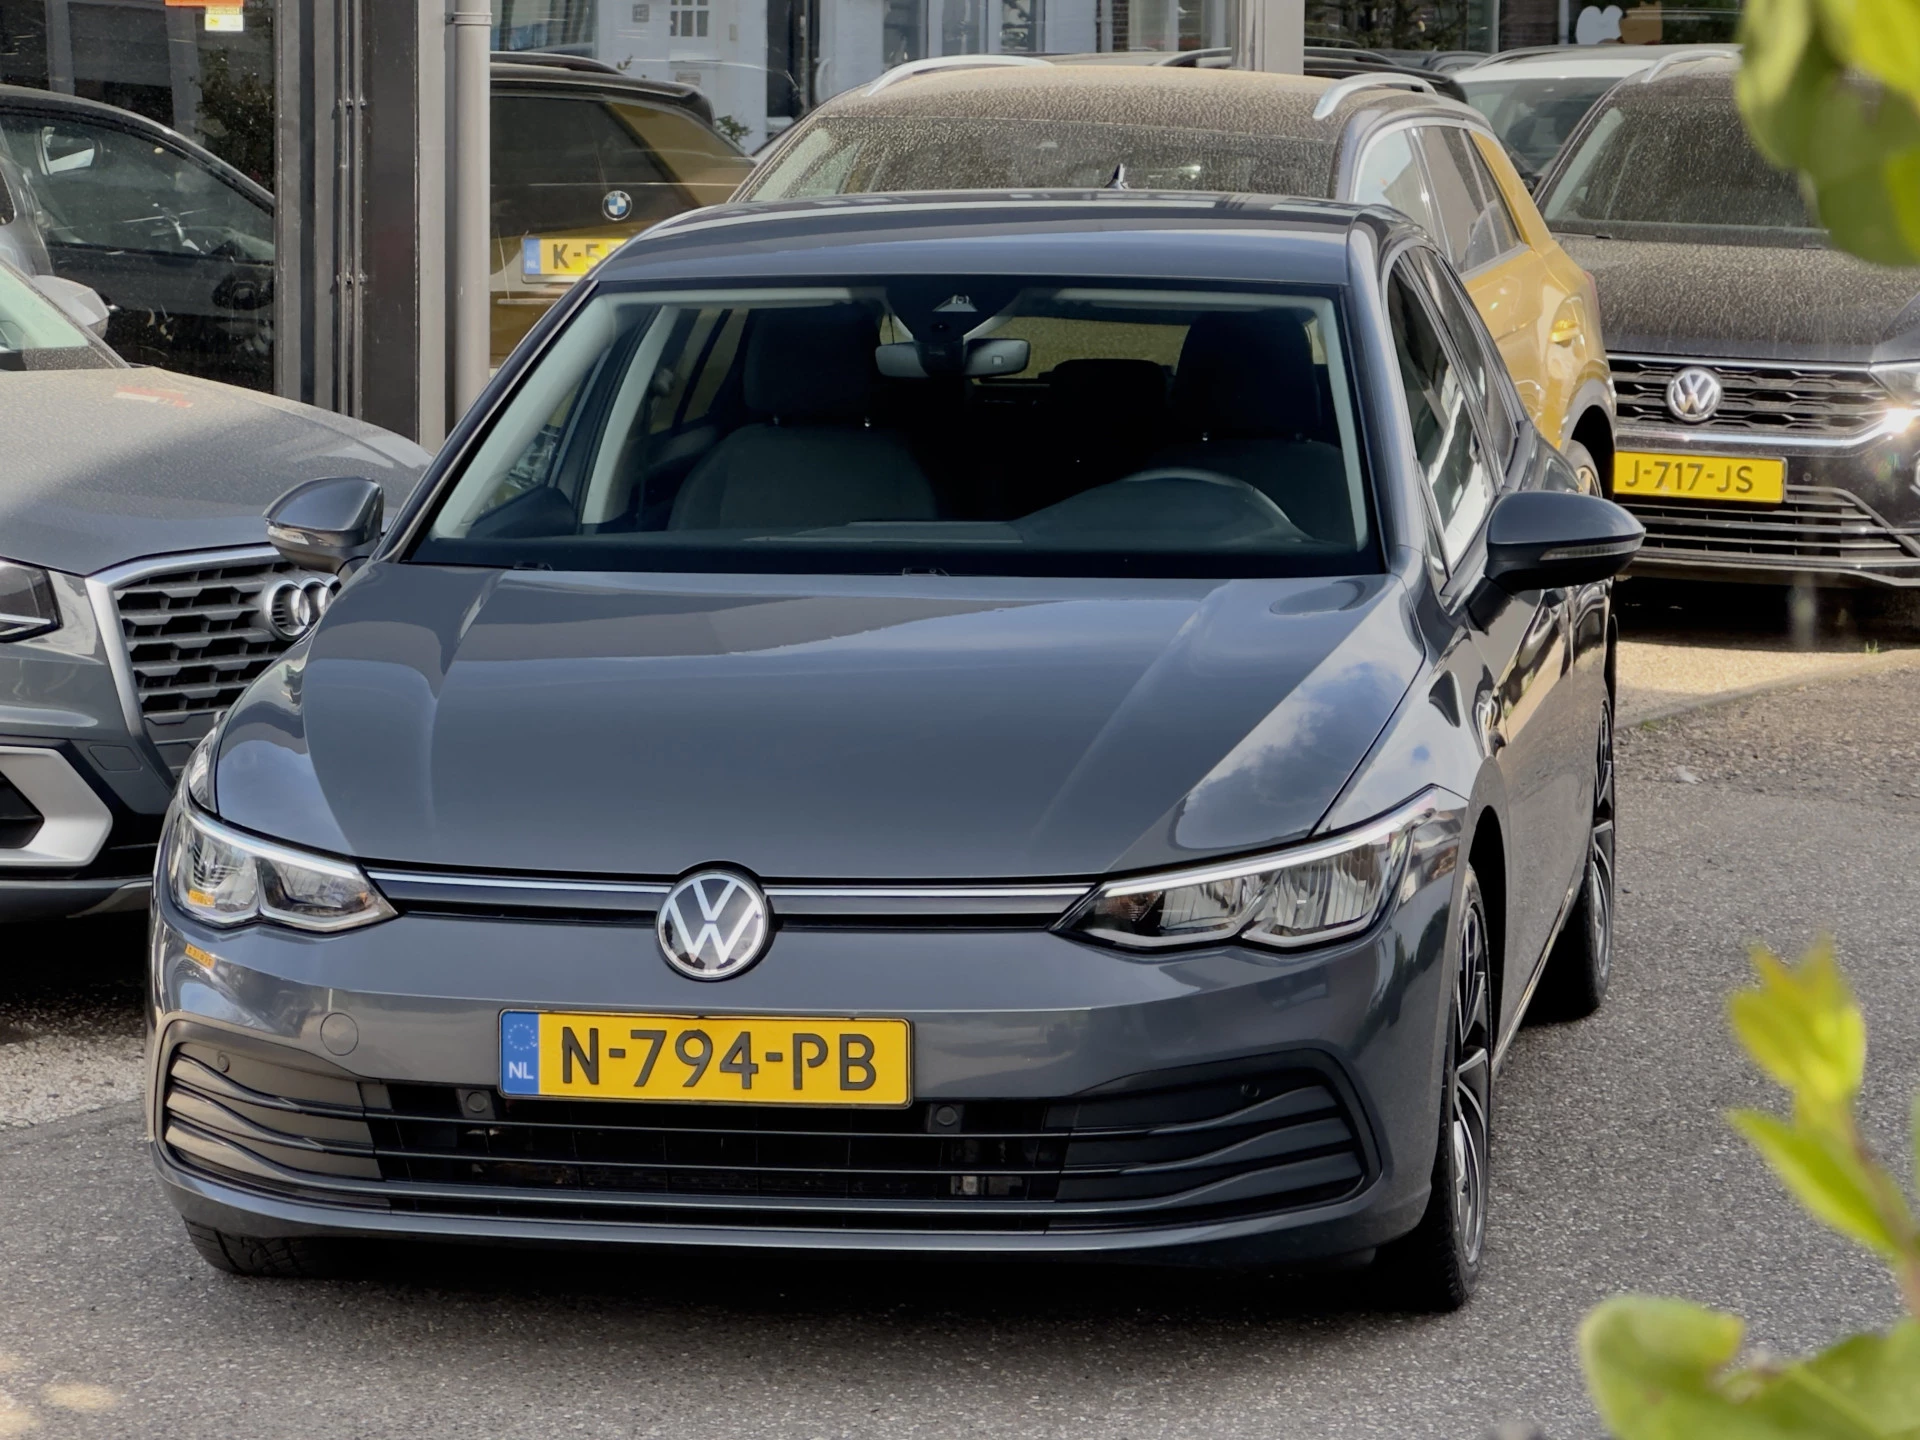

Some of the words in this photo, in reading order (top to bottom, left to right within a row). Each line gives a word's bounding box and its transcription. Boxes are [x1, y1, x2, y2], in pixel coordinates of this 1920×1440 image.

[1625, 459, 1753, 493] J-717-JS
[663, 875, 764, 970] VW
[509, 1061, 534, 1080] NL
[561, 1026, 877, 1091] N-794-PB
